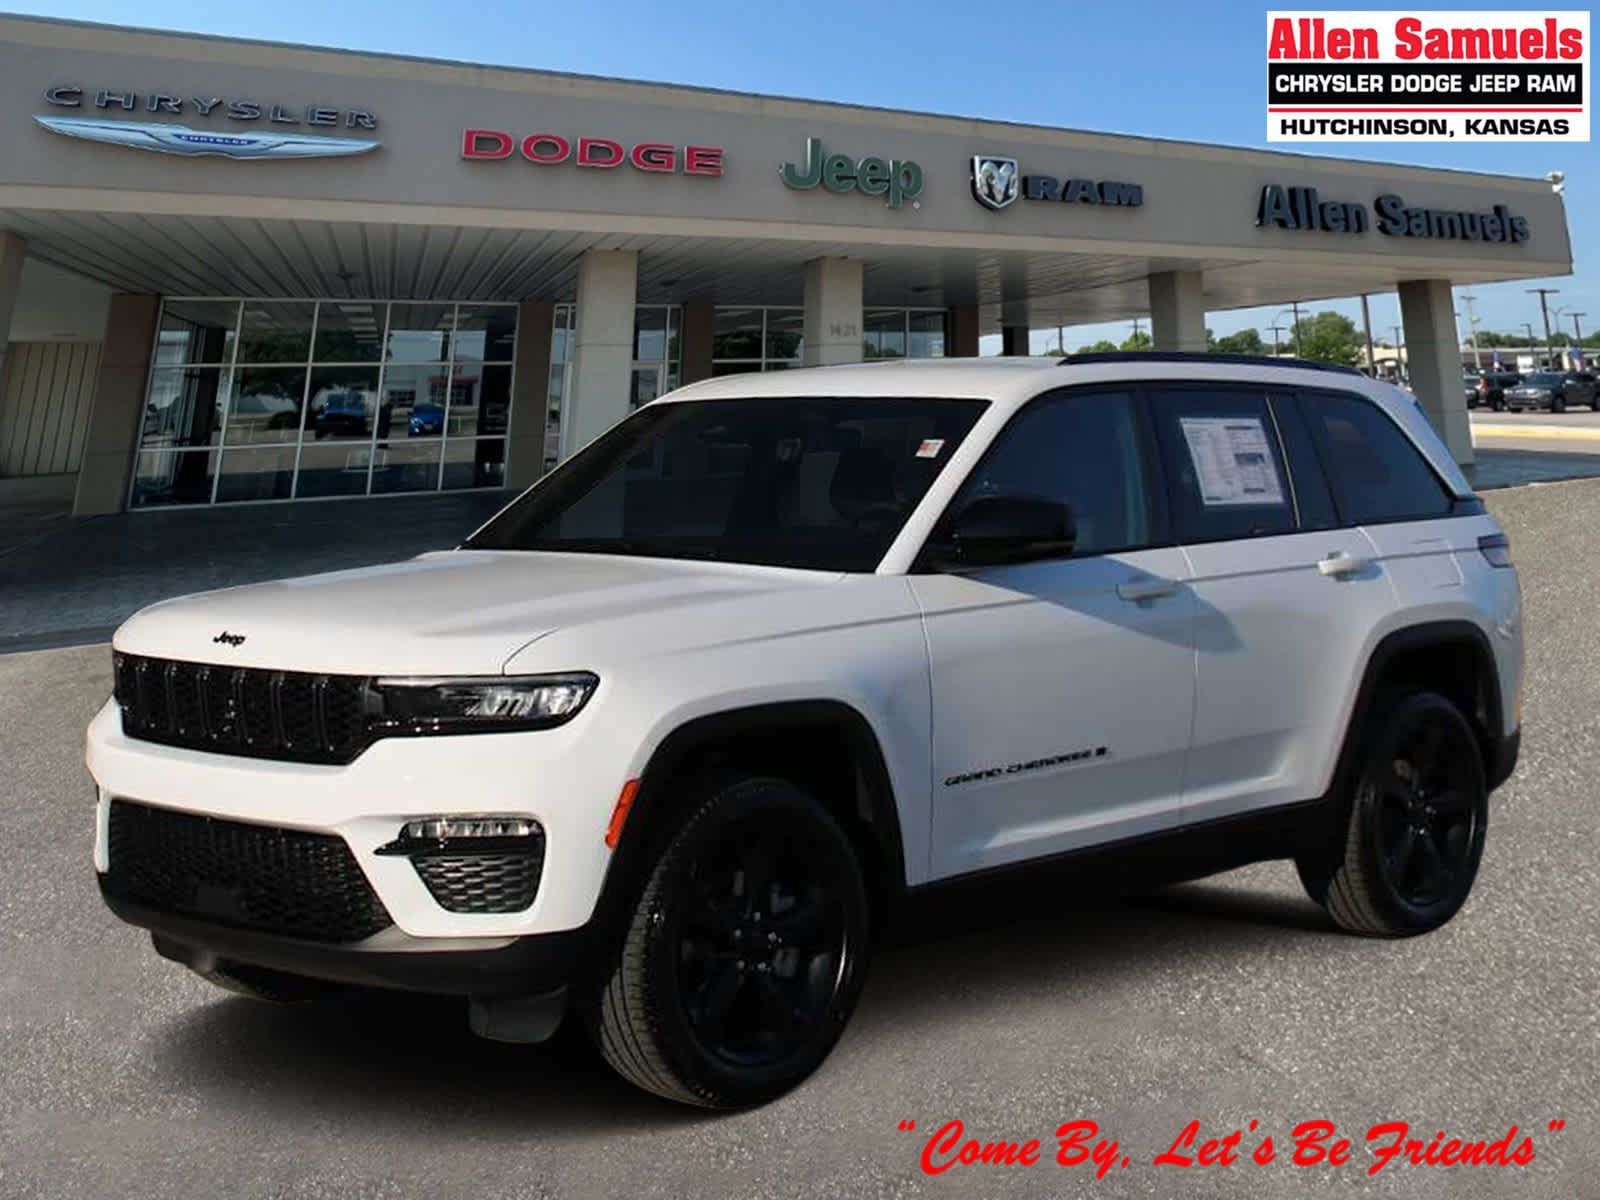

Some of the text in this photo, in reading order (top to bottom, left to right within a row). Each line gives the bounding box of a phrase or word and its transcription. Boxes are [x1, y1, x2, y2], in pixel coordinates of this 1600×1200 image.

[43, 86, 377, 129] CHRYSLER
[462, 129, 724, 176] DODGE
[779, 136, 923, 208] Jeep
[1022, 175, 1144, 207] RAM
[1255, 184, 1531, 242] Allen Samuels
[212, 630, 246, 647] Jeep
[944, 768, 1002, 787] GRAND
